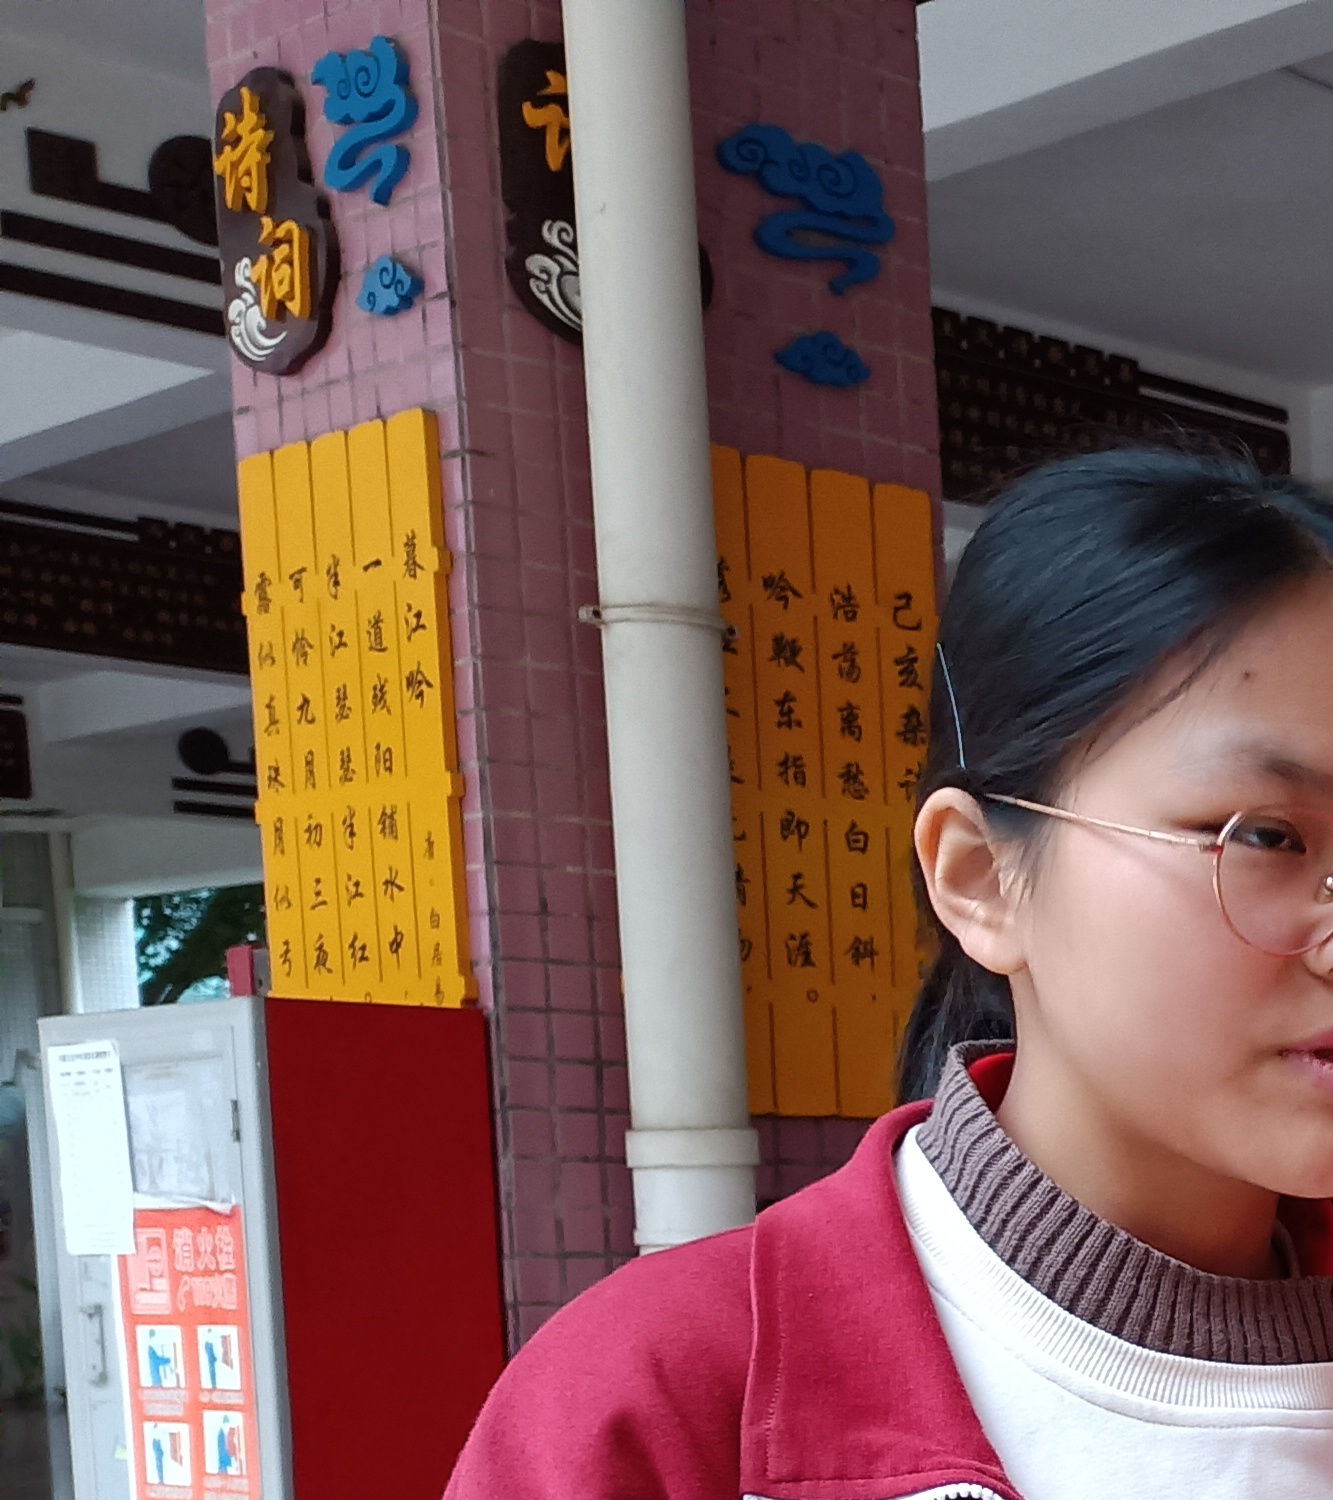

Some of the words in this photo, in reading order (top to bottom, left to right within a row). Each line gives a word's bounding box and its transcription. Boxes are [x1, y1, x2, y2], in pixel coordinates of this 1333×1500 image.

[214, 84, 312, 322] 诗词
[403, 529, 434, 709] 暮江吟
